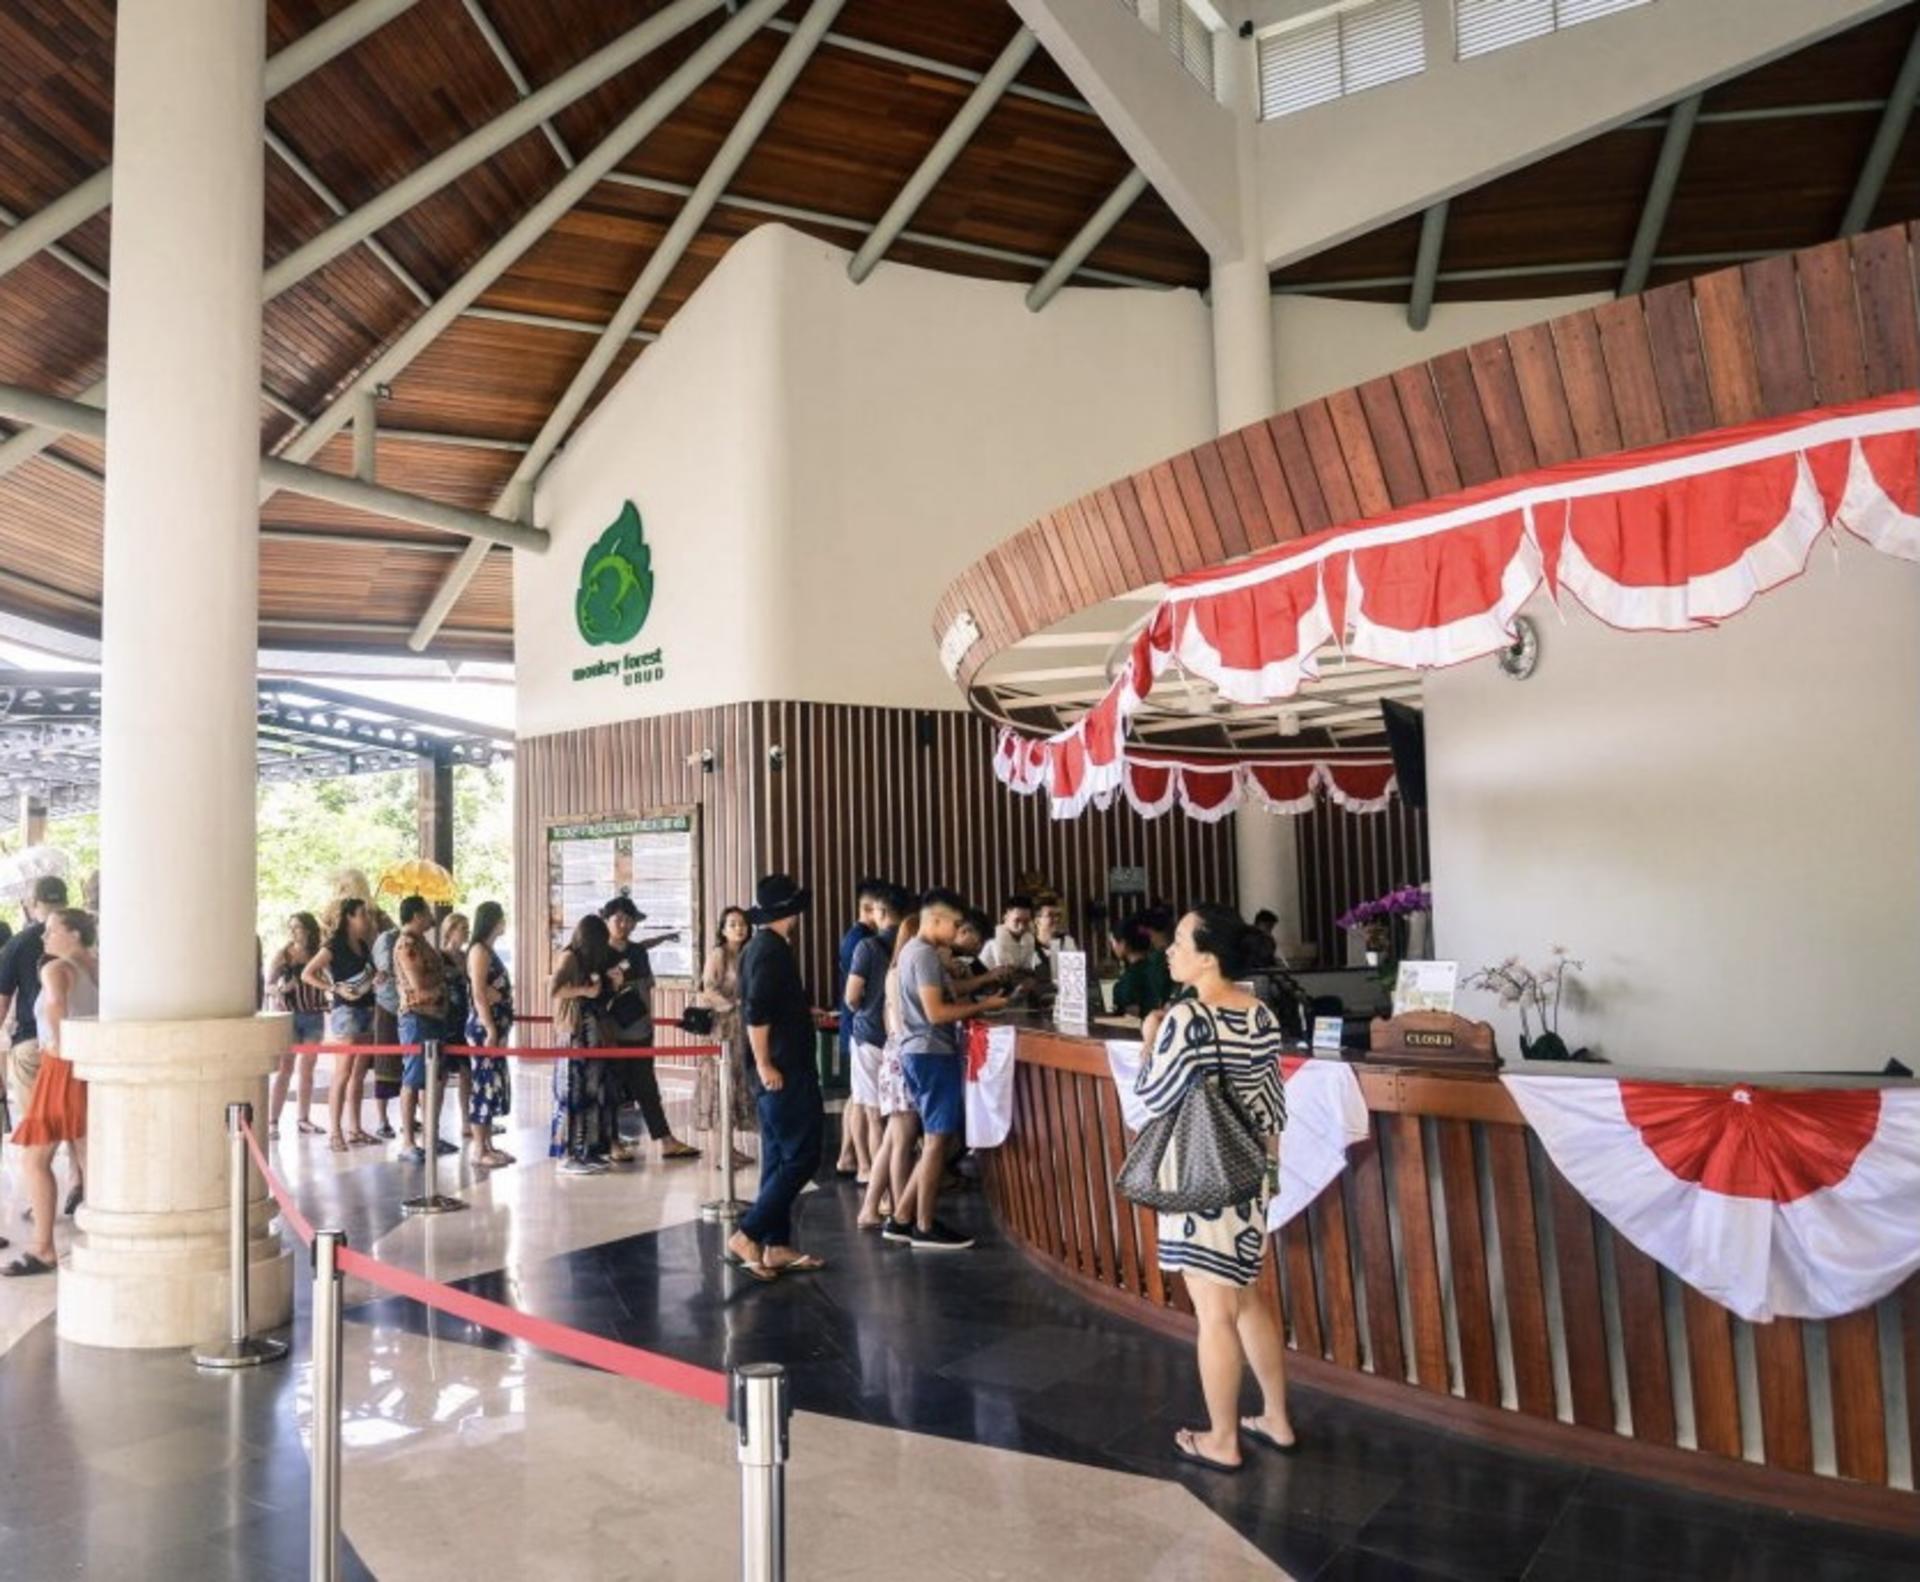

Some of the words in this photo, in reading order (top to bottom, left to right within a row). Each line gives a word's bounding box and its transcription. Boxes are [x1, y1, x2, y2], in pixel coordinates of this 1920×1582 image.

[572, 659, 620, 681] monkey
[623, 647, 662, 670] forest
[623, 667, 664, 686] UBUD
[1406, 1033, 1452, 1047] CLOSED
